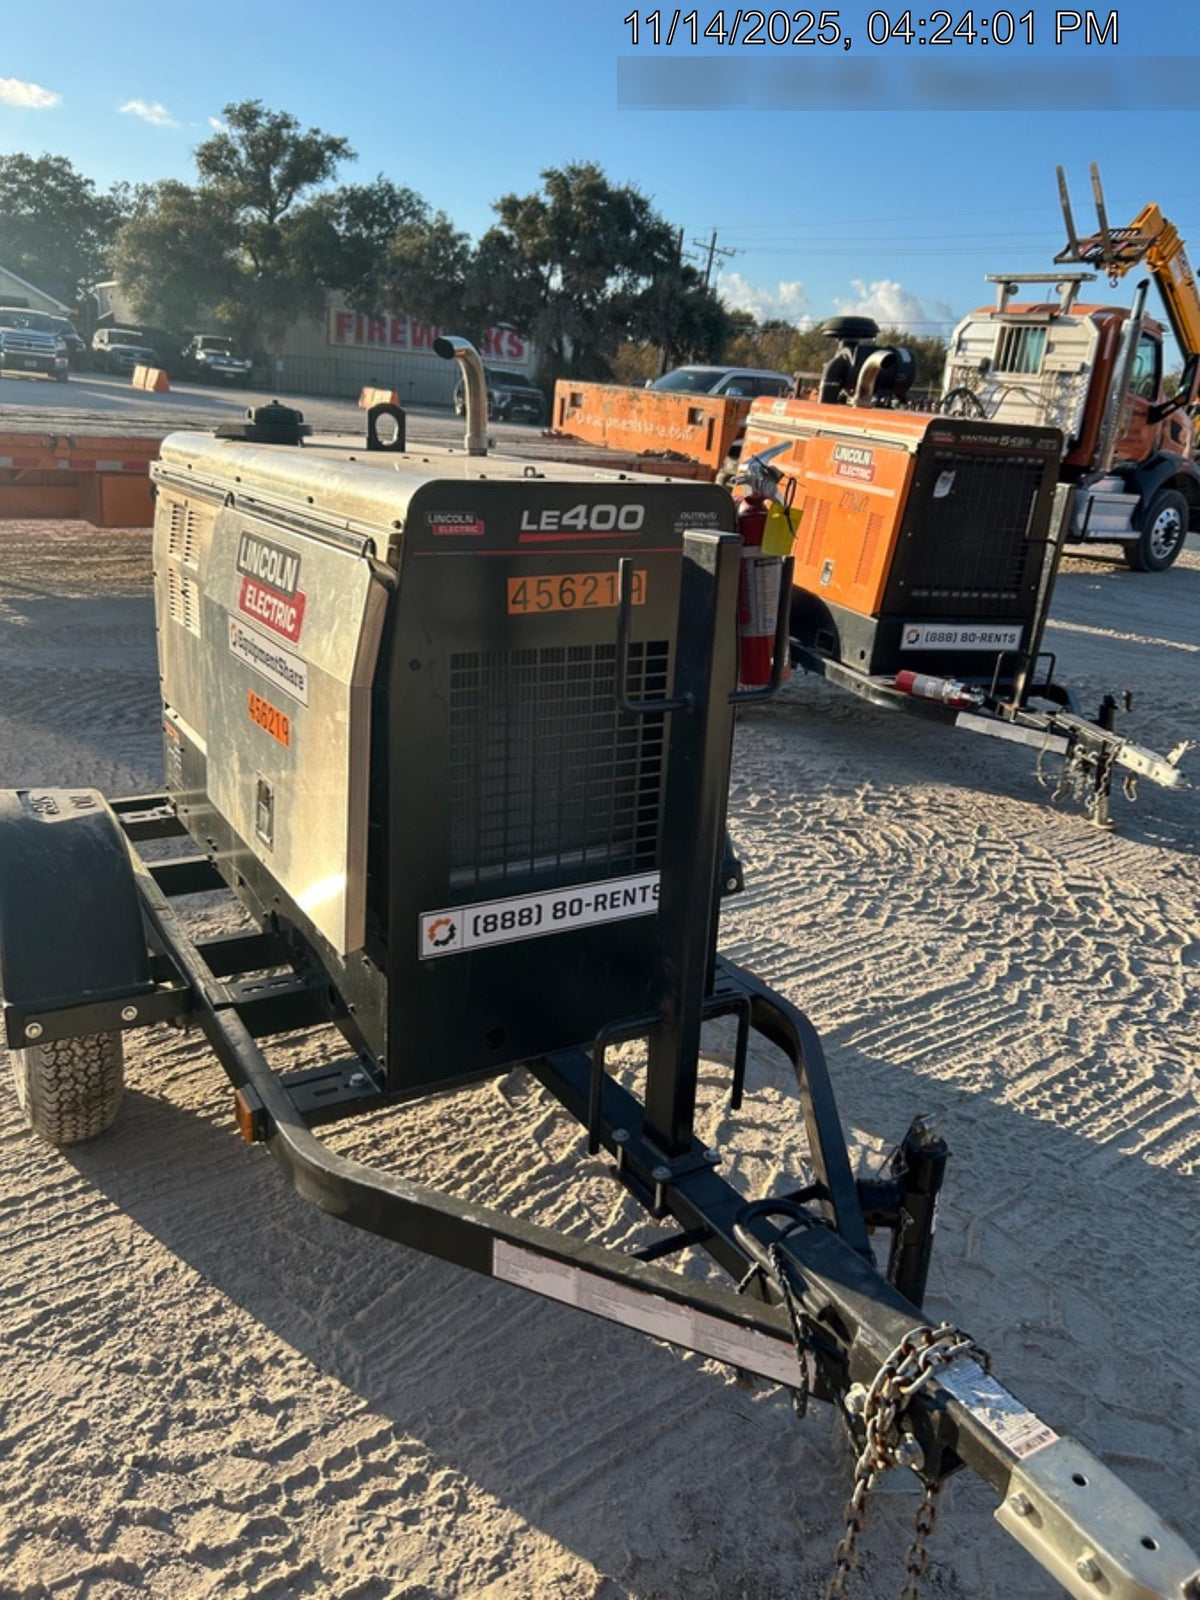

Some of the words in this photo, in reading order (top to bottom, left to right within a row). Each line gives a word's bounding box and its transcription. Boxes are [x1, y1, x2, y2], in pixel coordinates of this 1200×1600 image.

[335, 311, 525, 359] FIREWKS
[835, 445, 872, 465] LINCOLN
[838, 464, 873, 481] ELECTRIC
[428, 514, 474, 524] LINCOLN
[438, 525, 479, 533] ELECTRIC
[520, 504, 645, 531] LE400
[239, 536, 298, 593] LINCOLN
[511, 573, 642, 610] 456219
[244, 584, 297, 633] ELECTRIC
[925, 631, 957, 643] (888)
[960, 632, 1017, 644] 80-RENTS
[473, 903, 542, 937] (888)
[552, 883, 660, 920] 80-RENTS
